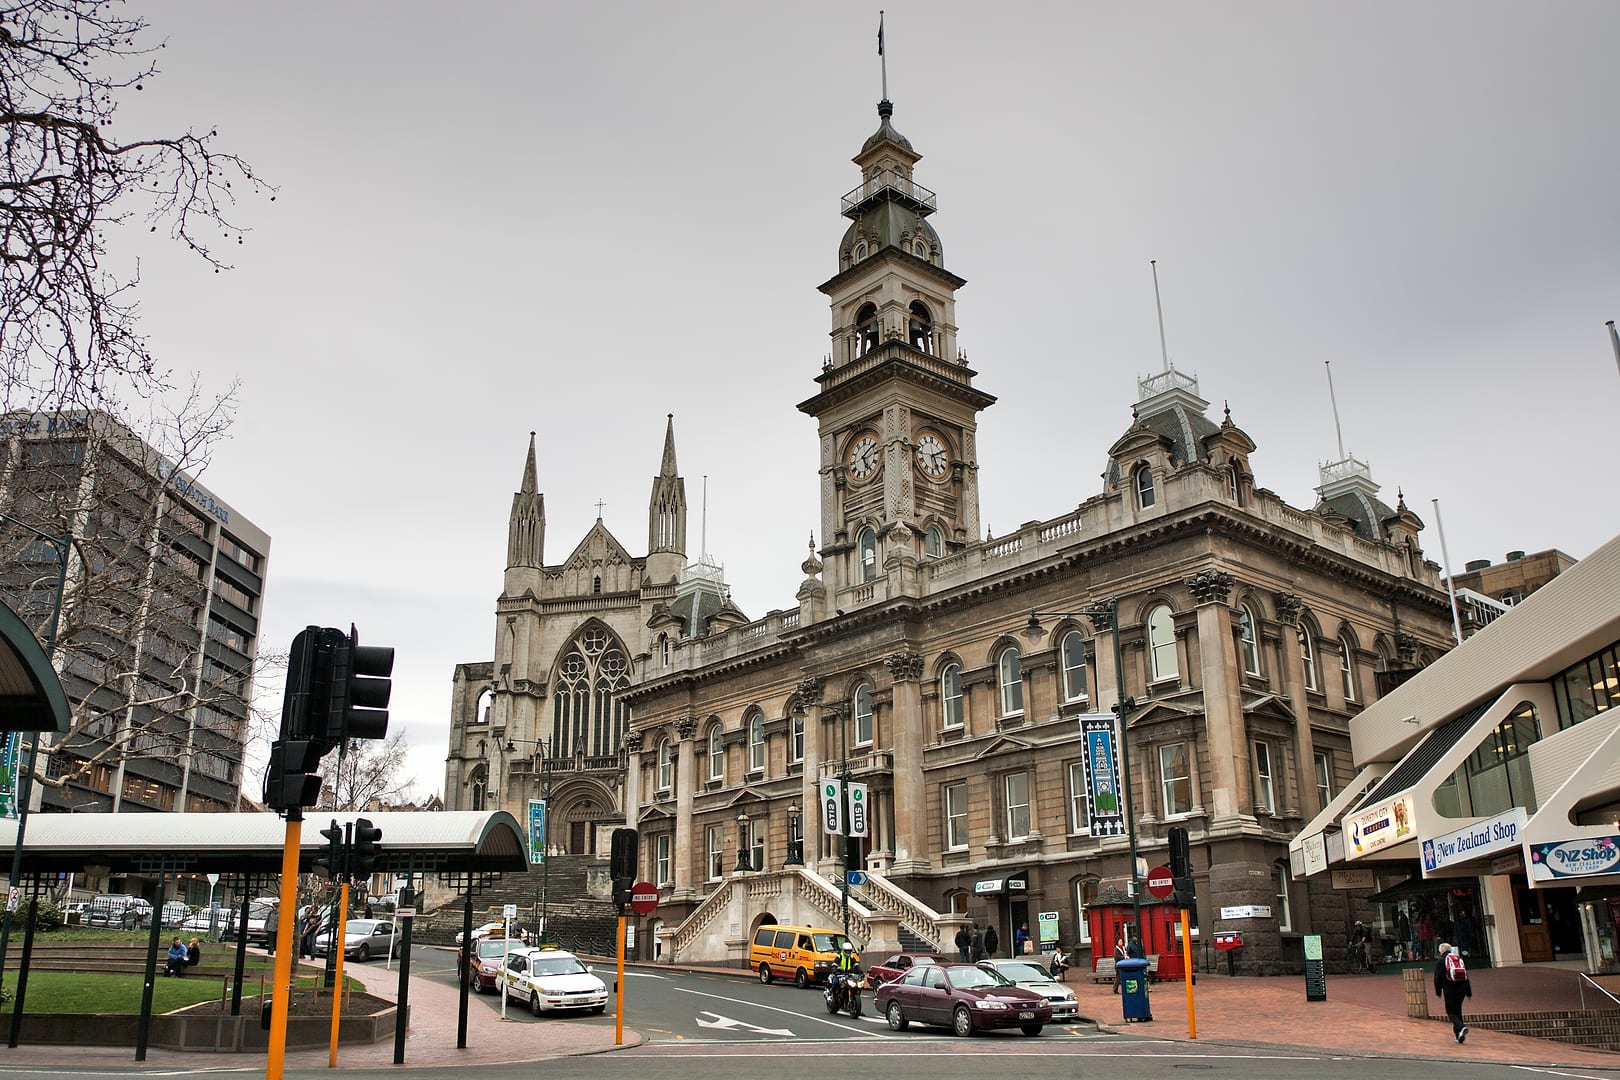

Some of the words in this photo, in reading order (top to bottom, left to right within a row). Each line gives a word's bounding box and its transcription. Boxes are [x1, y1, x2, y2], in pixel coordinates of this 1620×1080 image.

[1379, 806, 1388, 818] CITY
[1437, 842, 1455, 863] New
[1457, 826, 1491, 852] Zealand
[1494, 821, 1516, 841] Shop
[1554, 849, 1581, 863] NZ
[1581, 846, 1616, 861] Shop
